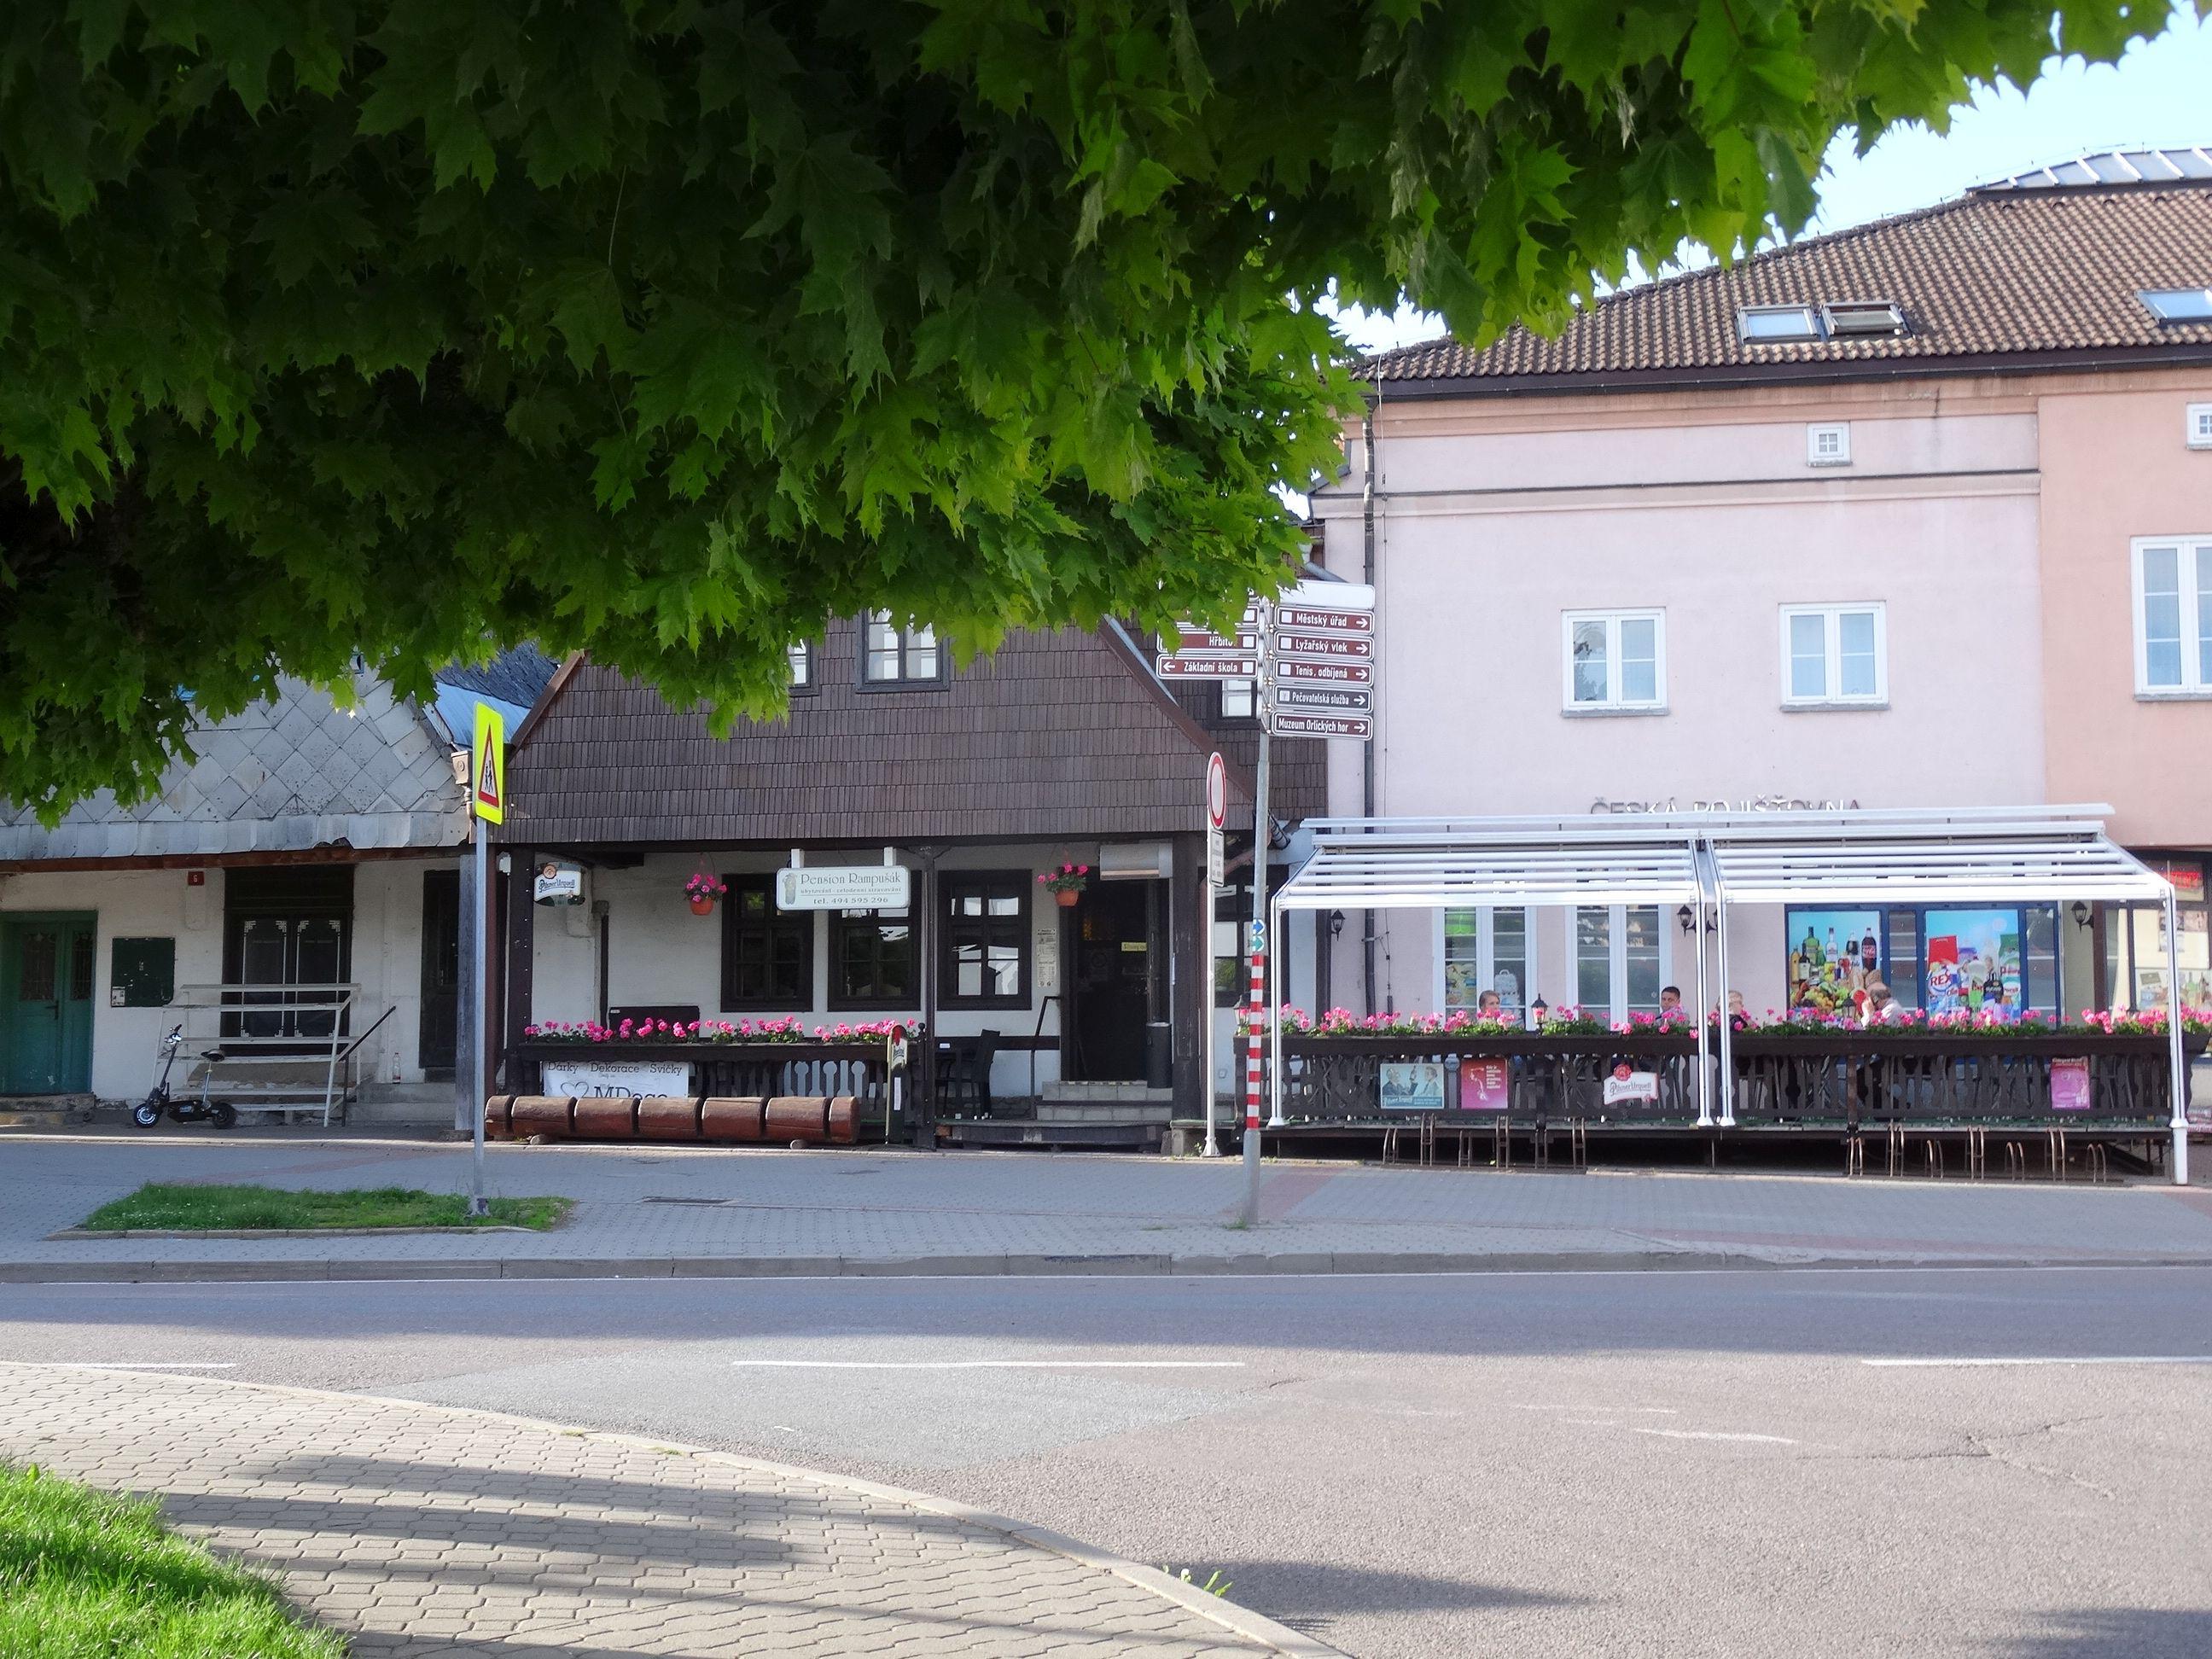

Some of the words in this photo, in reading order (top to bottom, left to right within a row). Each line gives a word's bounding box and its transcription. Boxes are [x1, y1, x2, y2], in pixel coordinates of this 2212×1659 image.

[1296, 613, 1327, 627] Městský
[1330, 615, 1347, 626] úřad
[1295, 638, 1329, 654] Lyžařský
[1331, 642, 1348, 653] vlek
[1184, 661, 1215, 672] Základní
[1218, 661, 1238, 672] škola
[1318, 667, 1348, 679] odbíjená
[1292, 691, 1330, 704] Pečovatelská
[1330, 694, 1349, 705] služba
[1278, 718, 1305, 730] Muzeum
[1306, 719, 1336, 733] Orlických
[1337, 722, 1348, 732] hor
[800, 873, 845, 885] Pension
[848, 871, 901, 887] Rampušák
[591, 1063, 640, 1073] Dekorace
